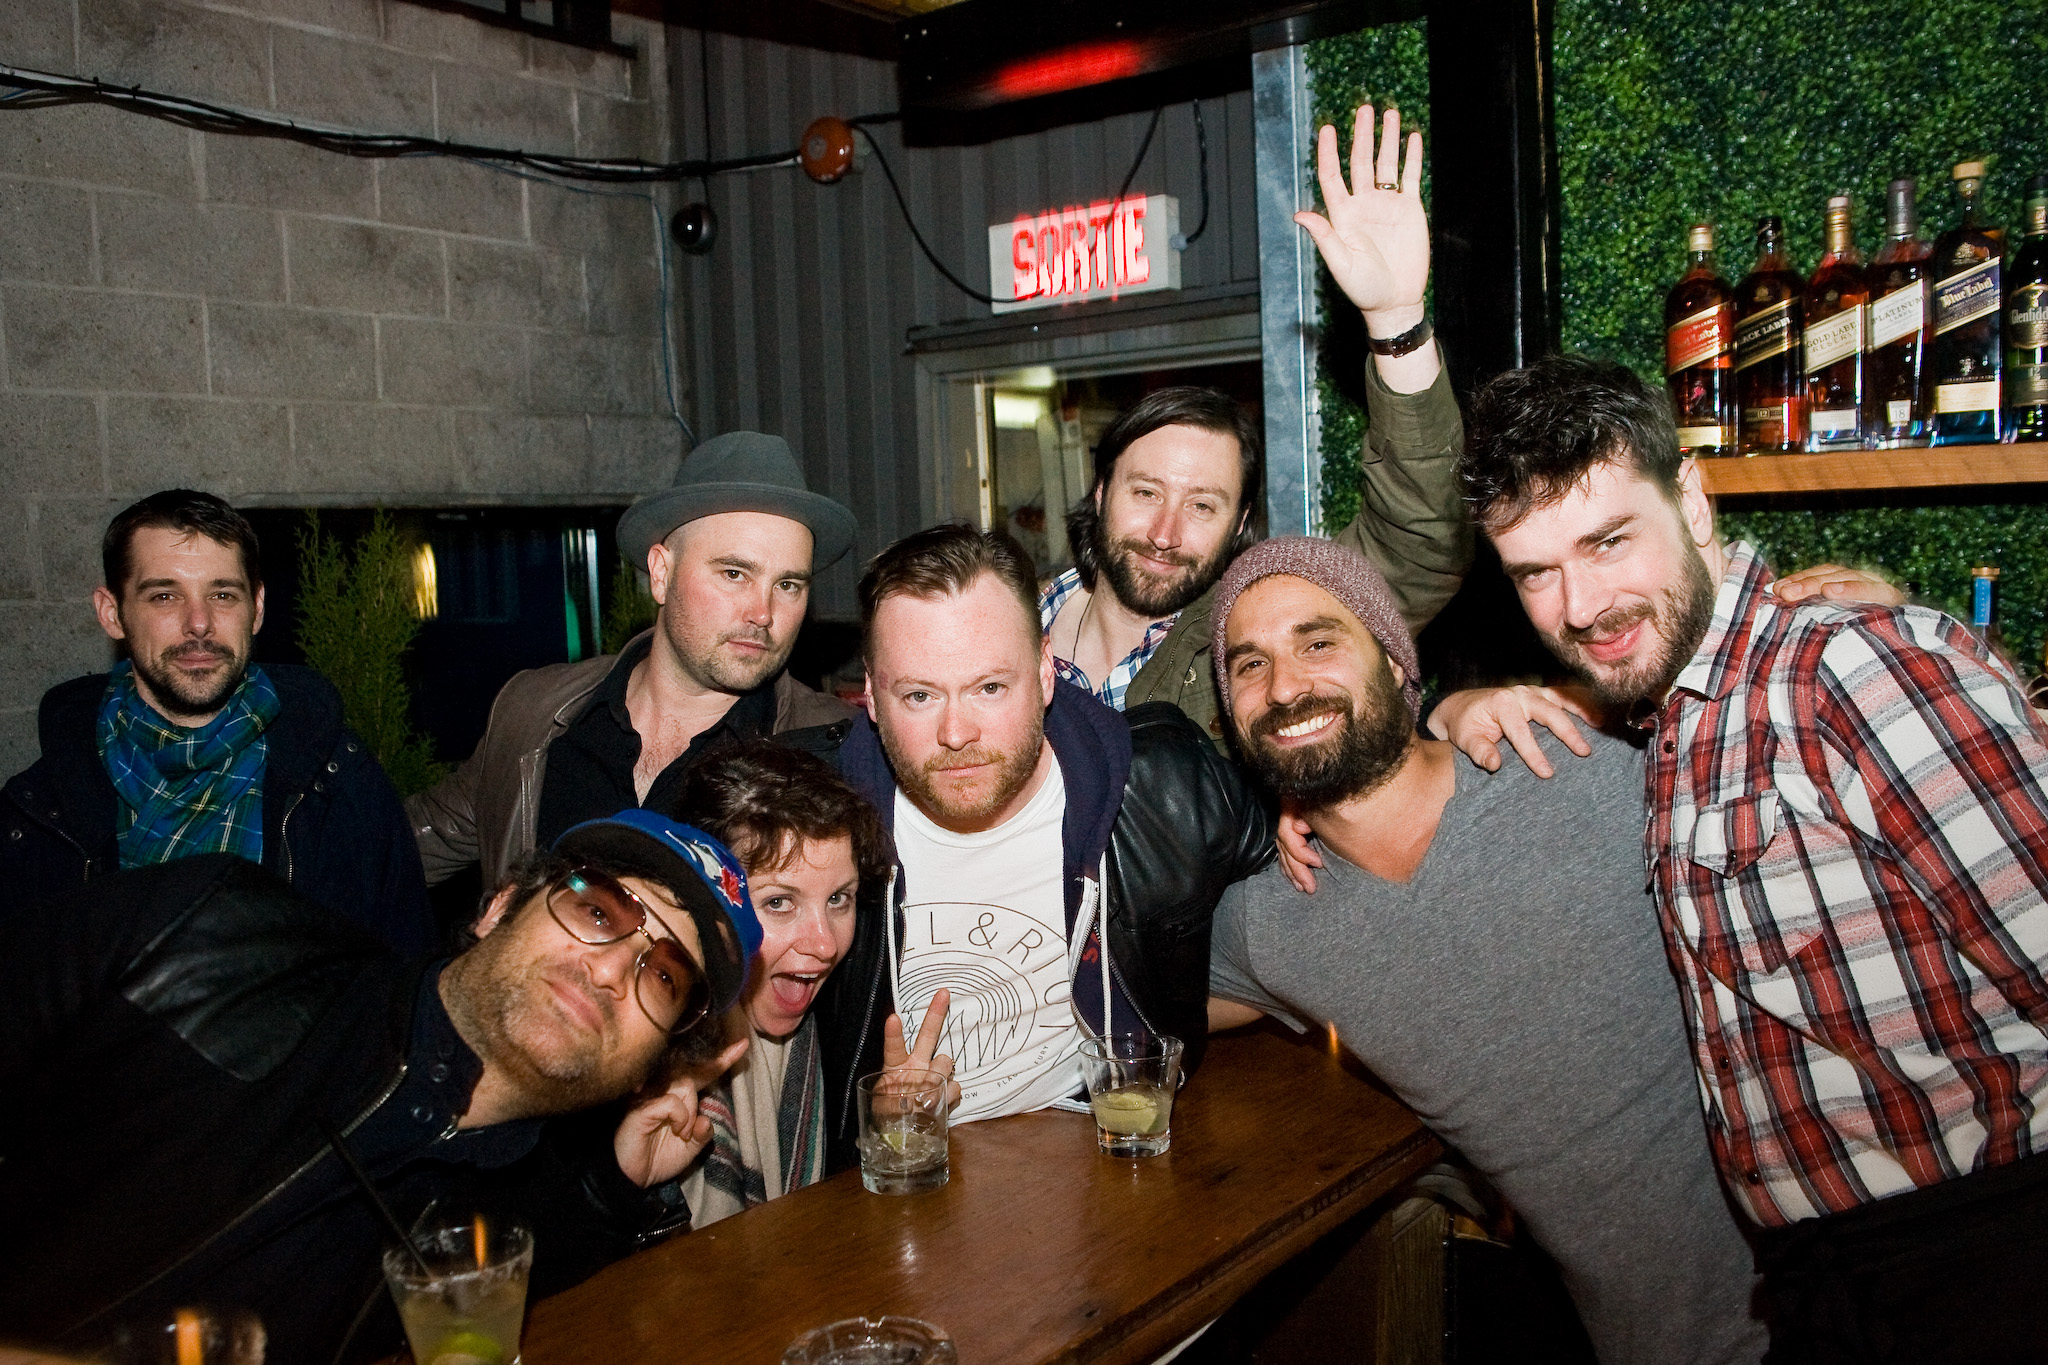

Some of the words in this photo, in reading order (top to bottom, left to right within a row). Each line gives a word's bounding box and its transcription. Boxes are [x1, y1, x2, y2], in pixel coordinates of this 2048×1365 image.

[1013, 196, 1149, 299] SORTIE
[1940, 290, 1966, 308] Blue
[1963, 277, 1994, 297] Label
[1871, 295, 1924, 325] PLATINUM
[1763, 317, 1793, 335] LABEL
[1806, 332, 1831, 348] GOLD
[1832, 321, 1857, 337] LABE
[2029, 367, 2041, 377] 12
[1894, 408, 1906, 419] 18
[968, 912, 998, 949] &
[1034, 1045, 1049, 1065] FURY
